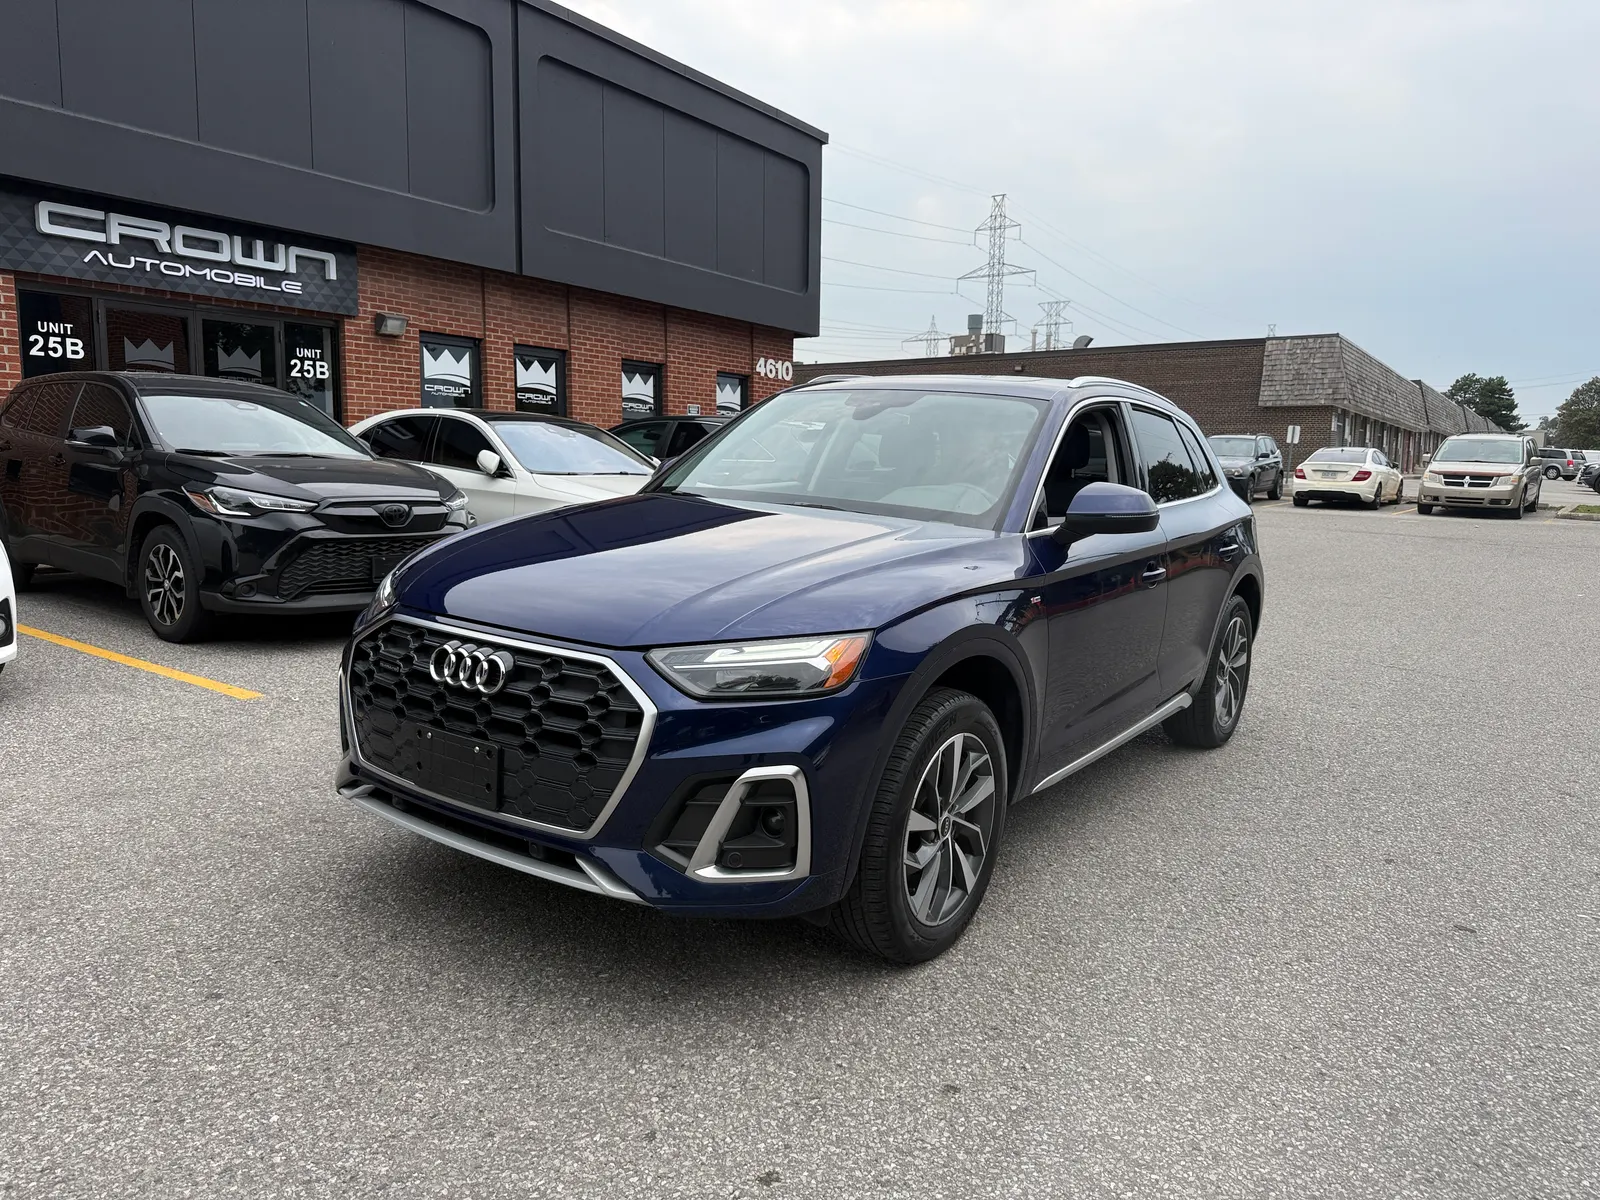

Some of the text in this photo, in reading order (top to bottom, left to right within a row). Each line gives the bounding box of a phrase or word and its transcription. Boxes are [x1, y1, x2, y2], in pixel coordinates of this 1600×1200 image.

[34, 200, 337, 280] CROWN
[83, 249, 303, 294] AUTOMOBILE
[37, 320, 74, 335] UNIT
[28, 334, 85, 360] 25B
[296, 347, 322, 359] UNIT
[290, 359, 330, 379] 25B
[755, 356, 793, 382] 4610
[424, 384, 471, 394] CROWN
[516, 392, 557, 402] CROWN
